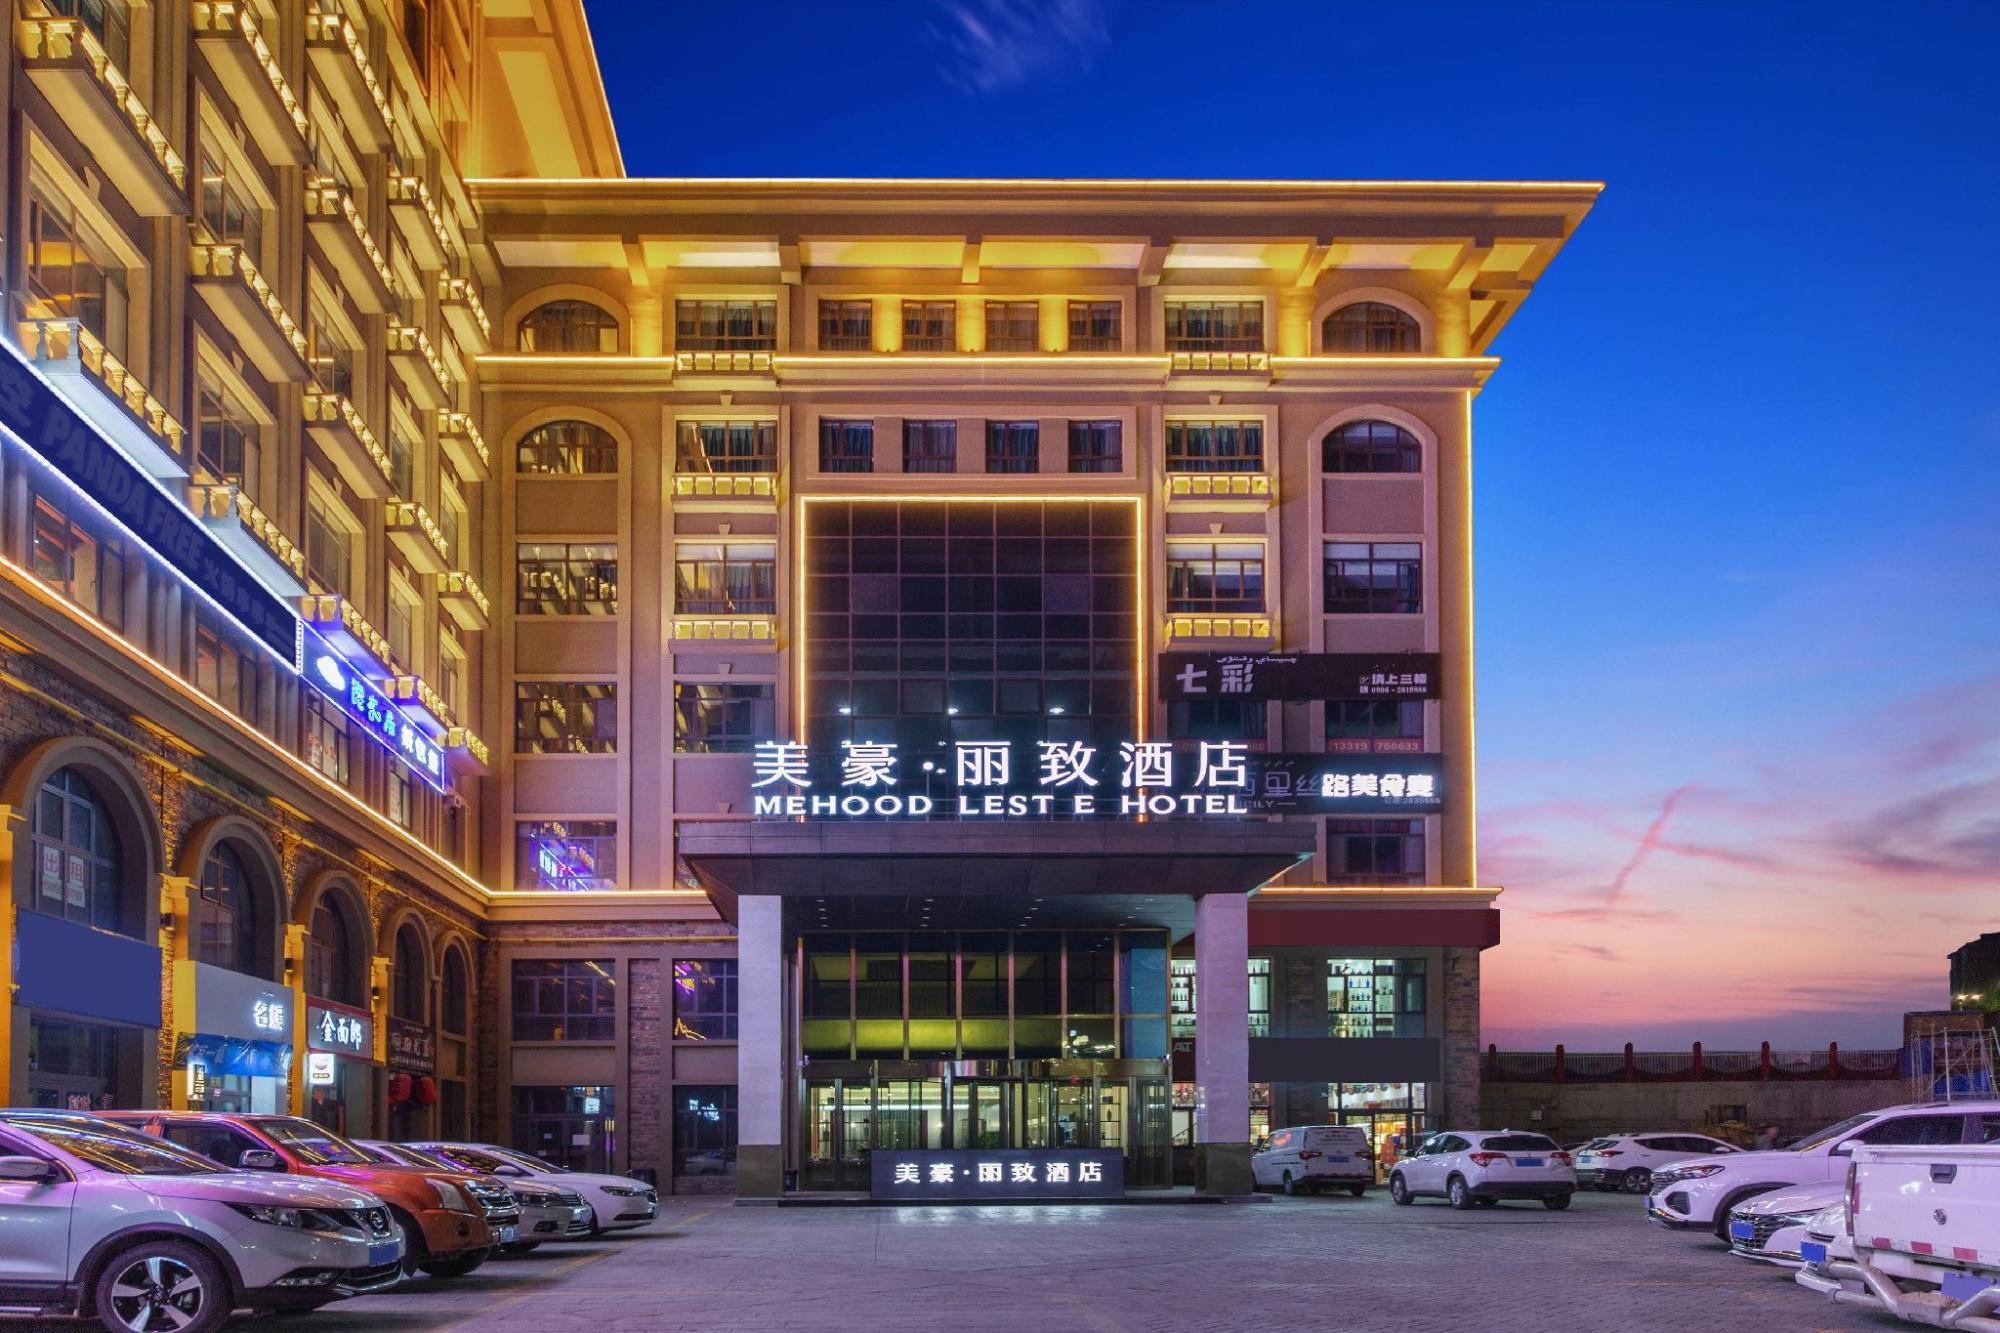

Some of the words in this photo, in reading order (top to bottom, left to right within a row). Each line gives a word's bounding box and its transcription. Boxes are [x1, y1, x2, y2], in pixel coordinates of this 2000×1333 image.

[40, 403, 148, 525] PANDA
[146, 507, 205, 571] FREE
[1176, 663, 1254, 693] 七彩
[754, 795, 933, 815] MEHOOD
[1121, 795, 1248, 815] HOTEL
